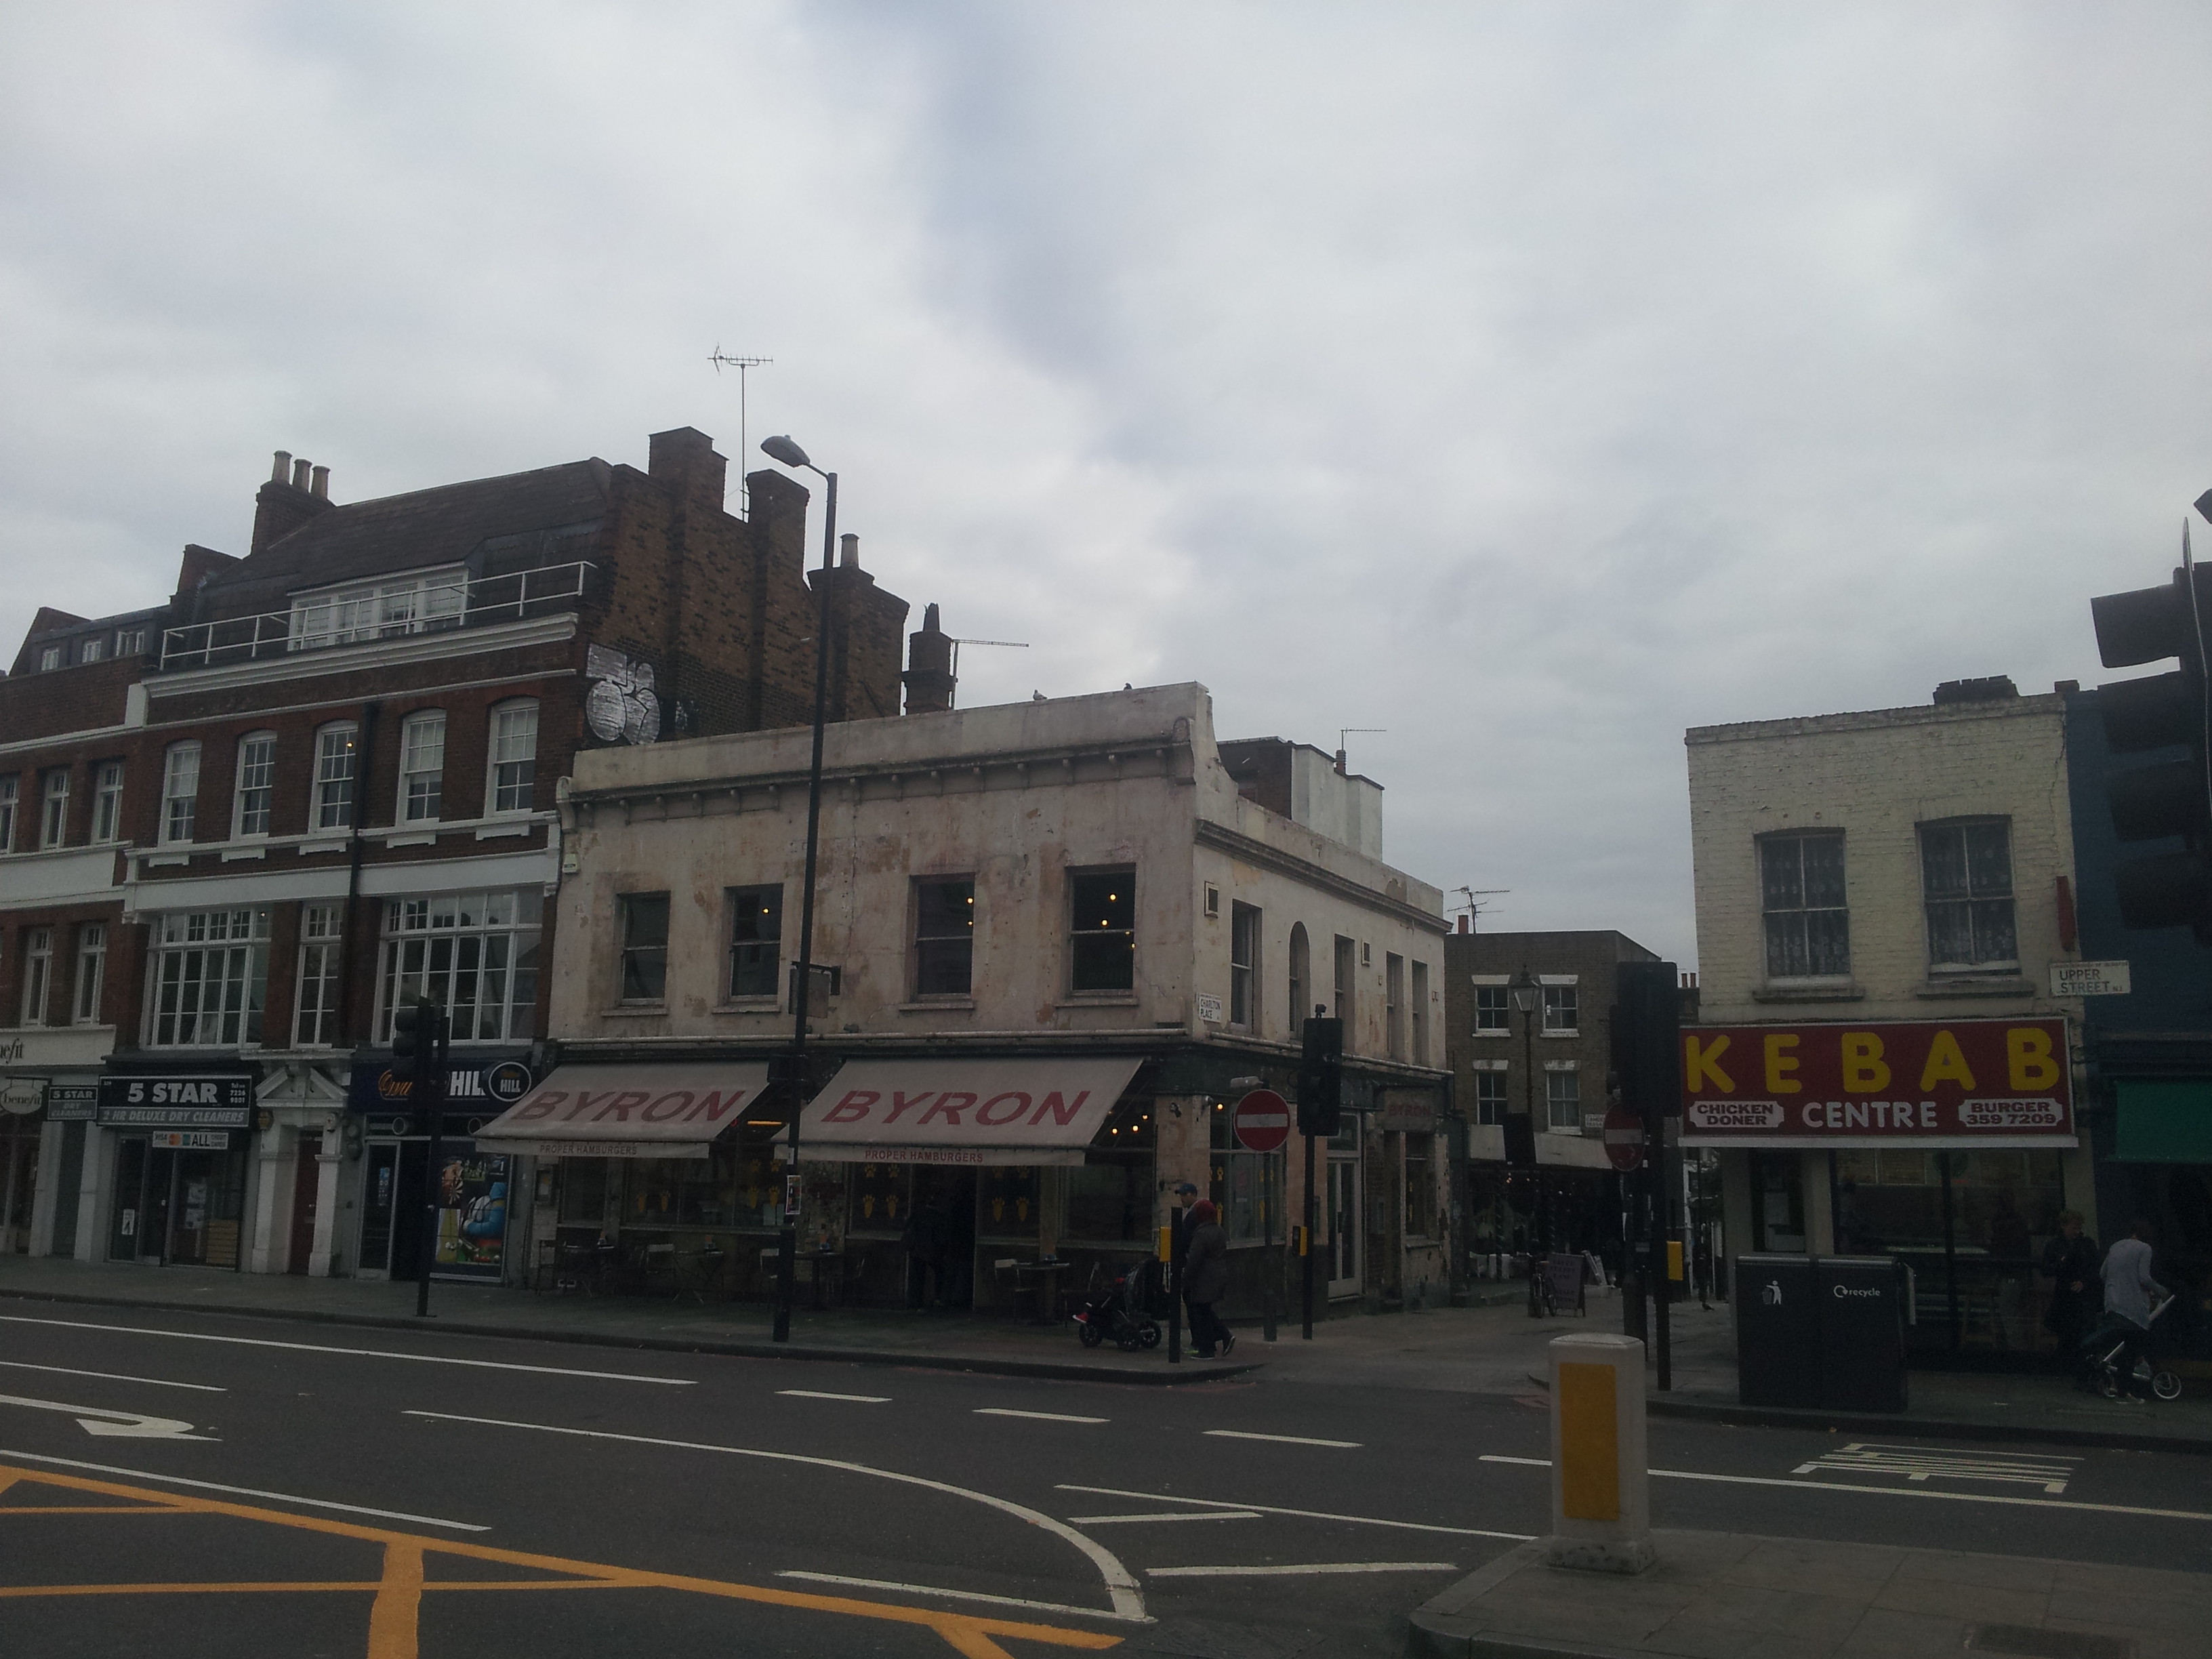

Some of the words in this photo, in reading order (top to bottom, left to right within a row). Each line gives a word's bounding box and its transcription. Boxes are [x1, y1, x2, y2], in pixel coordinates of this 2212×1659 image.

[2060, 969, 2100, 981] UPPER
[2061, 981, 2110, 993] STREET
[1200, 1008, 1212, 1019] PLACE
[1685, 1027, 2060, 1093] KEBAB
[500, 1079, 520, 1092] HILL
[54, 1090, 61, 1099] 5
[64, 1090, 93, 1099] STAR
[127, 1082, 144, 1103] 5
[151, 1082, 218, 1103] STAR
[3, 1092, 41, 1107] benefit
[510, 1090, 745, 1122] BYRON
[821, 1090, 1090, 1126] BYRON
[1388, 1104, 1431, 1117] BYRON
[1697, 1104, 1774, 1114] CHICKEN
[1971, 1102, 2050, 1113] BURGER
[112, 1110, 127, 1121] HR
[129, 1110, 166, 1122] DELUXE
[169, 1111, 190, 1122] DRY
[192, 1111, 244, 1122] CLEANERS
[1706, 1115, 1767, 1125] DONER
[1802, 1101, 1938, 1128] CENTRE
[1967, 1113, 2003, 1125] 359
[2007, 1113, 2056, 1124] 7209
[192, 1134, 210, 1147] ALL
[540, 1145, 574, 1153] PROPER
[577, 1146, 638, 1155] HAMBURGERS
[865, 1150, 906, 1160] PROPER
[910, 1152, 983, 1163] HAMBURGERS
[1849, 1288, 1881, 1297] recycle
